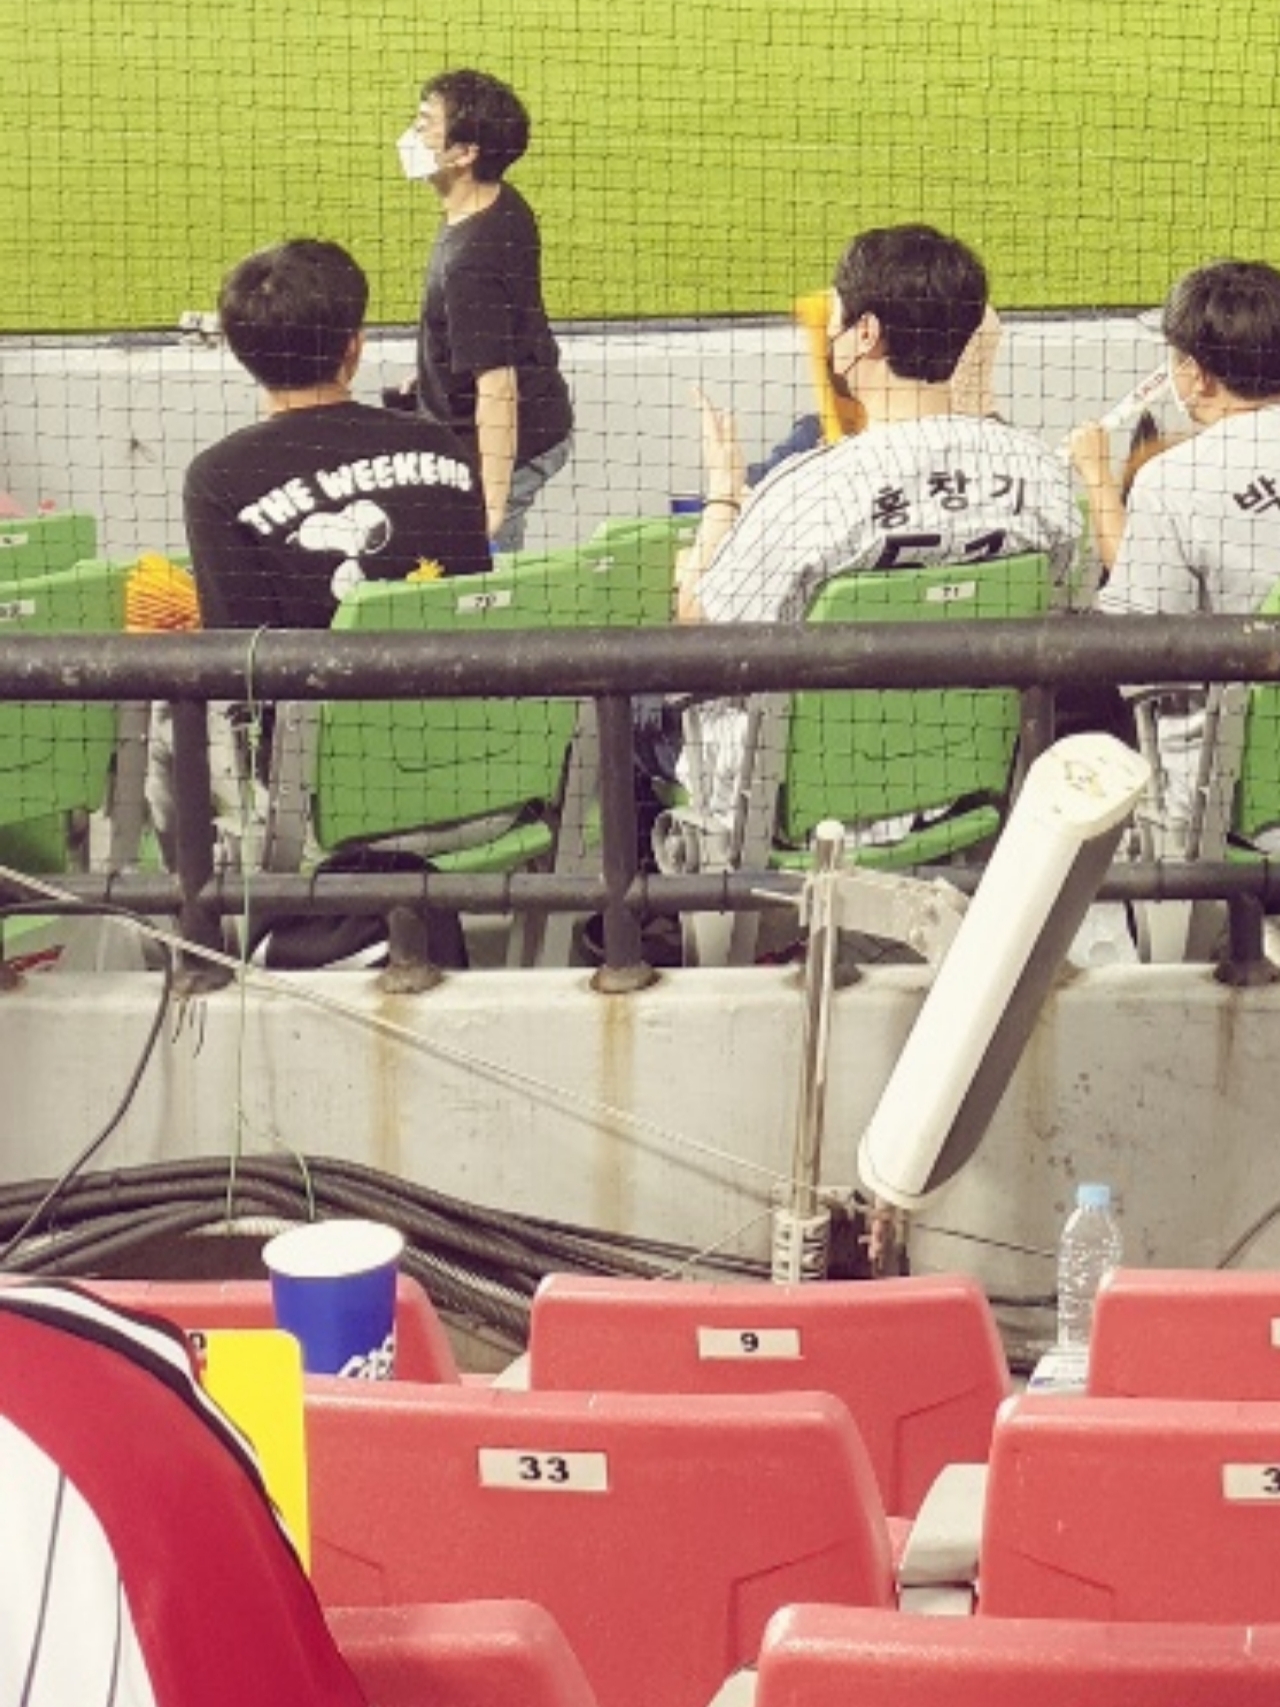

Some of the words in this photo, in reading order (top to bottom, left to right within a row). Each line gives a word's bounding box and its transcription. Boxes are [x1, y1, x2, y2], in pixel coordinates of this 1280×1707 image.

[237, 477, 316, 535] THE
[867, 468, 1026, 528] 홍창기
[740, 1331, 759, 1353] 9
[517, 1455, 571, 1484] 33
